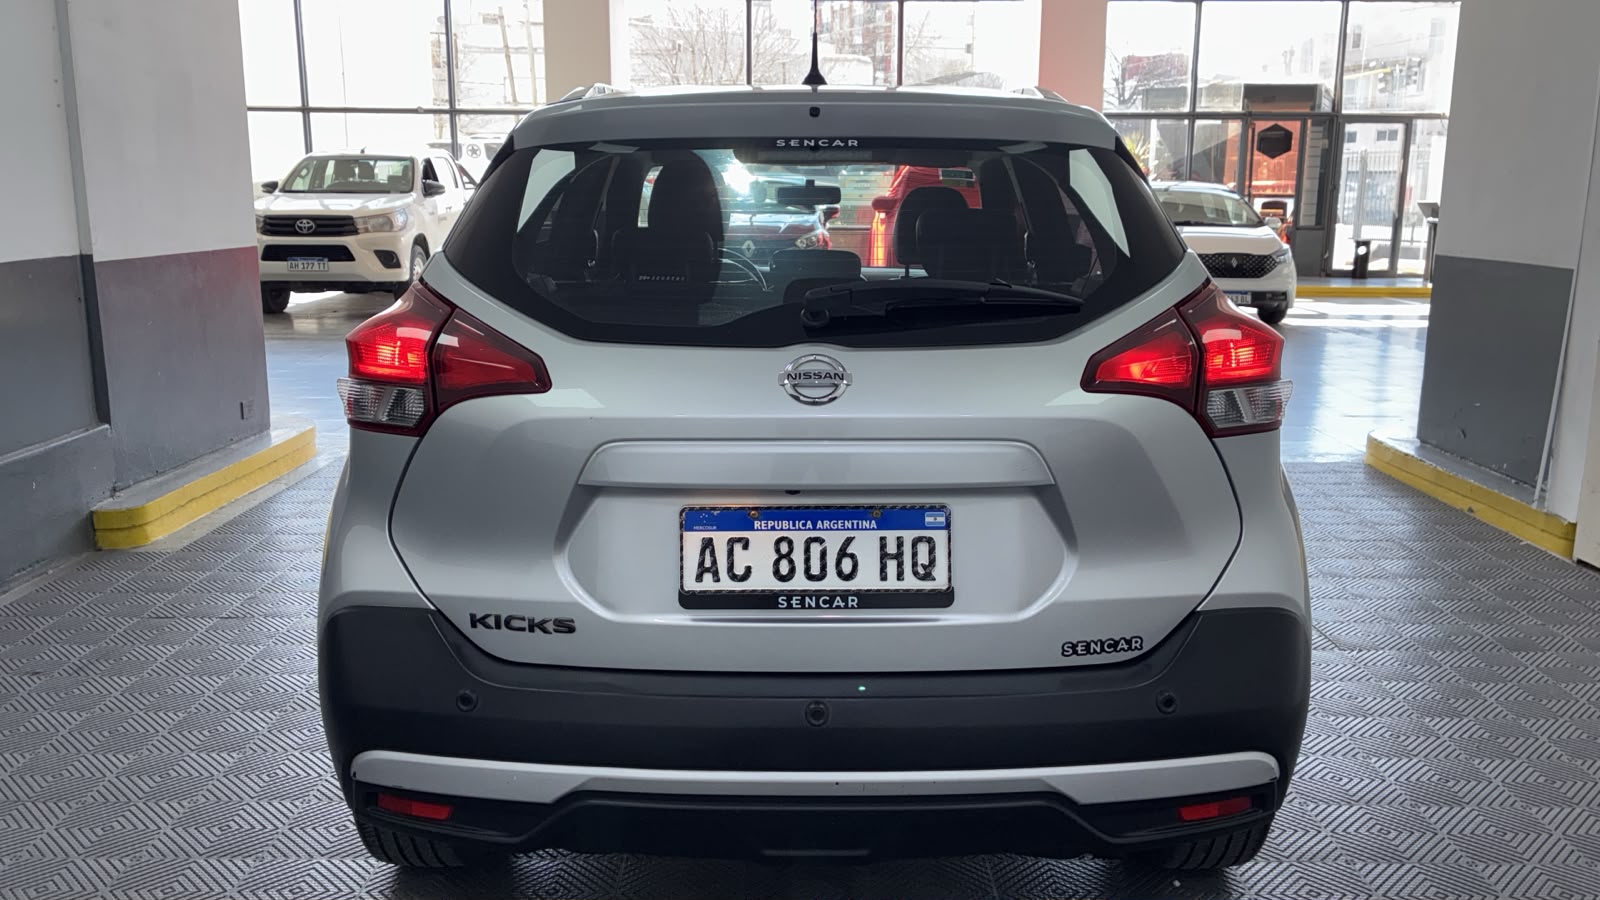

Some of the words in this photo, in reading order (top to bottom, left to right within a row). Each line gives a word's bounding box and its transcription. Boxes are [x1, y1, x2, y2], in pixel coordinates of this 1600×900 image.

[776, 139, 858, 147] SENCAR
[786, 372, 844, 381] NISSAN
[754, 520, 813, 530] REPUBLICA
[816, 519, 877, 529] ARGENTINA
[695, 536, 752, 583] AC
[772, 536, 859, 582] 806
[879, 536, 937, 581] HQ
[778, 596, 858, 608] SENCAR
[469, 613, 576, 634] KICKS
[1062, 637, 1143, 656] SENCAR
